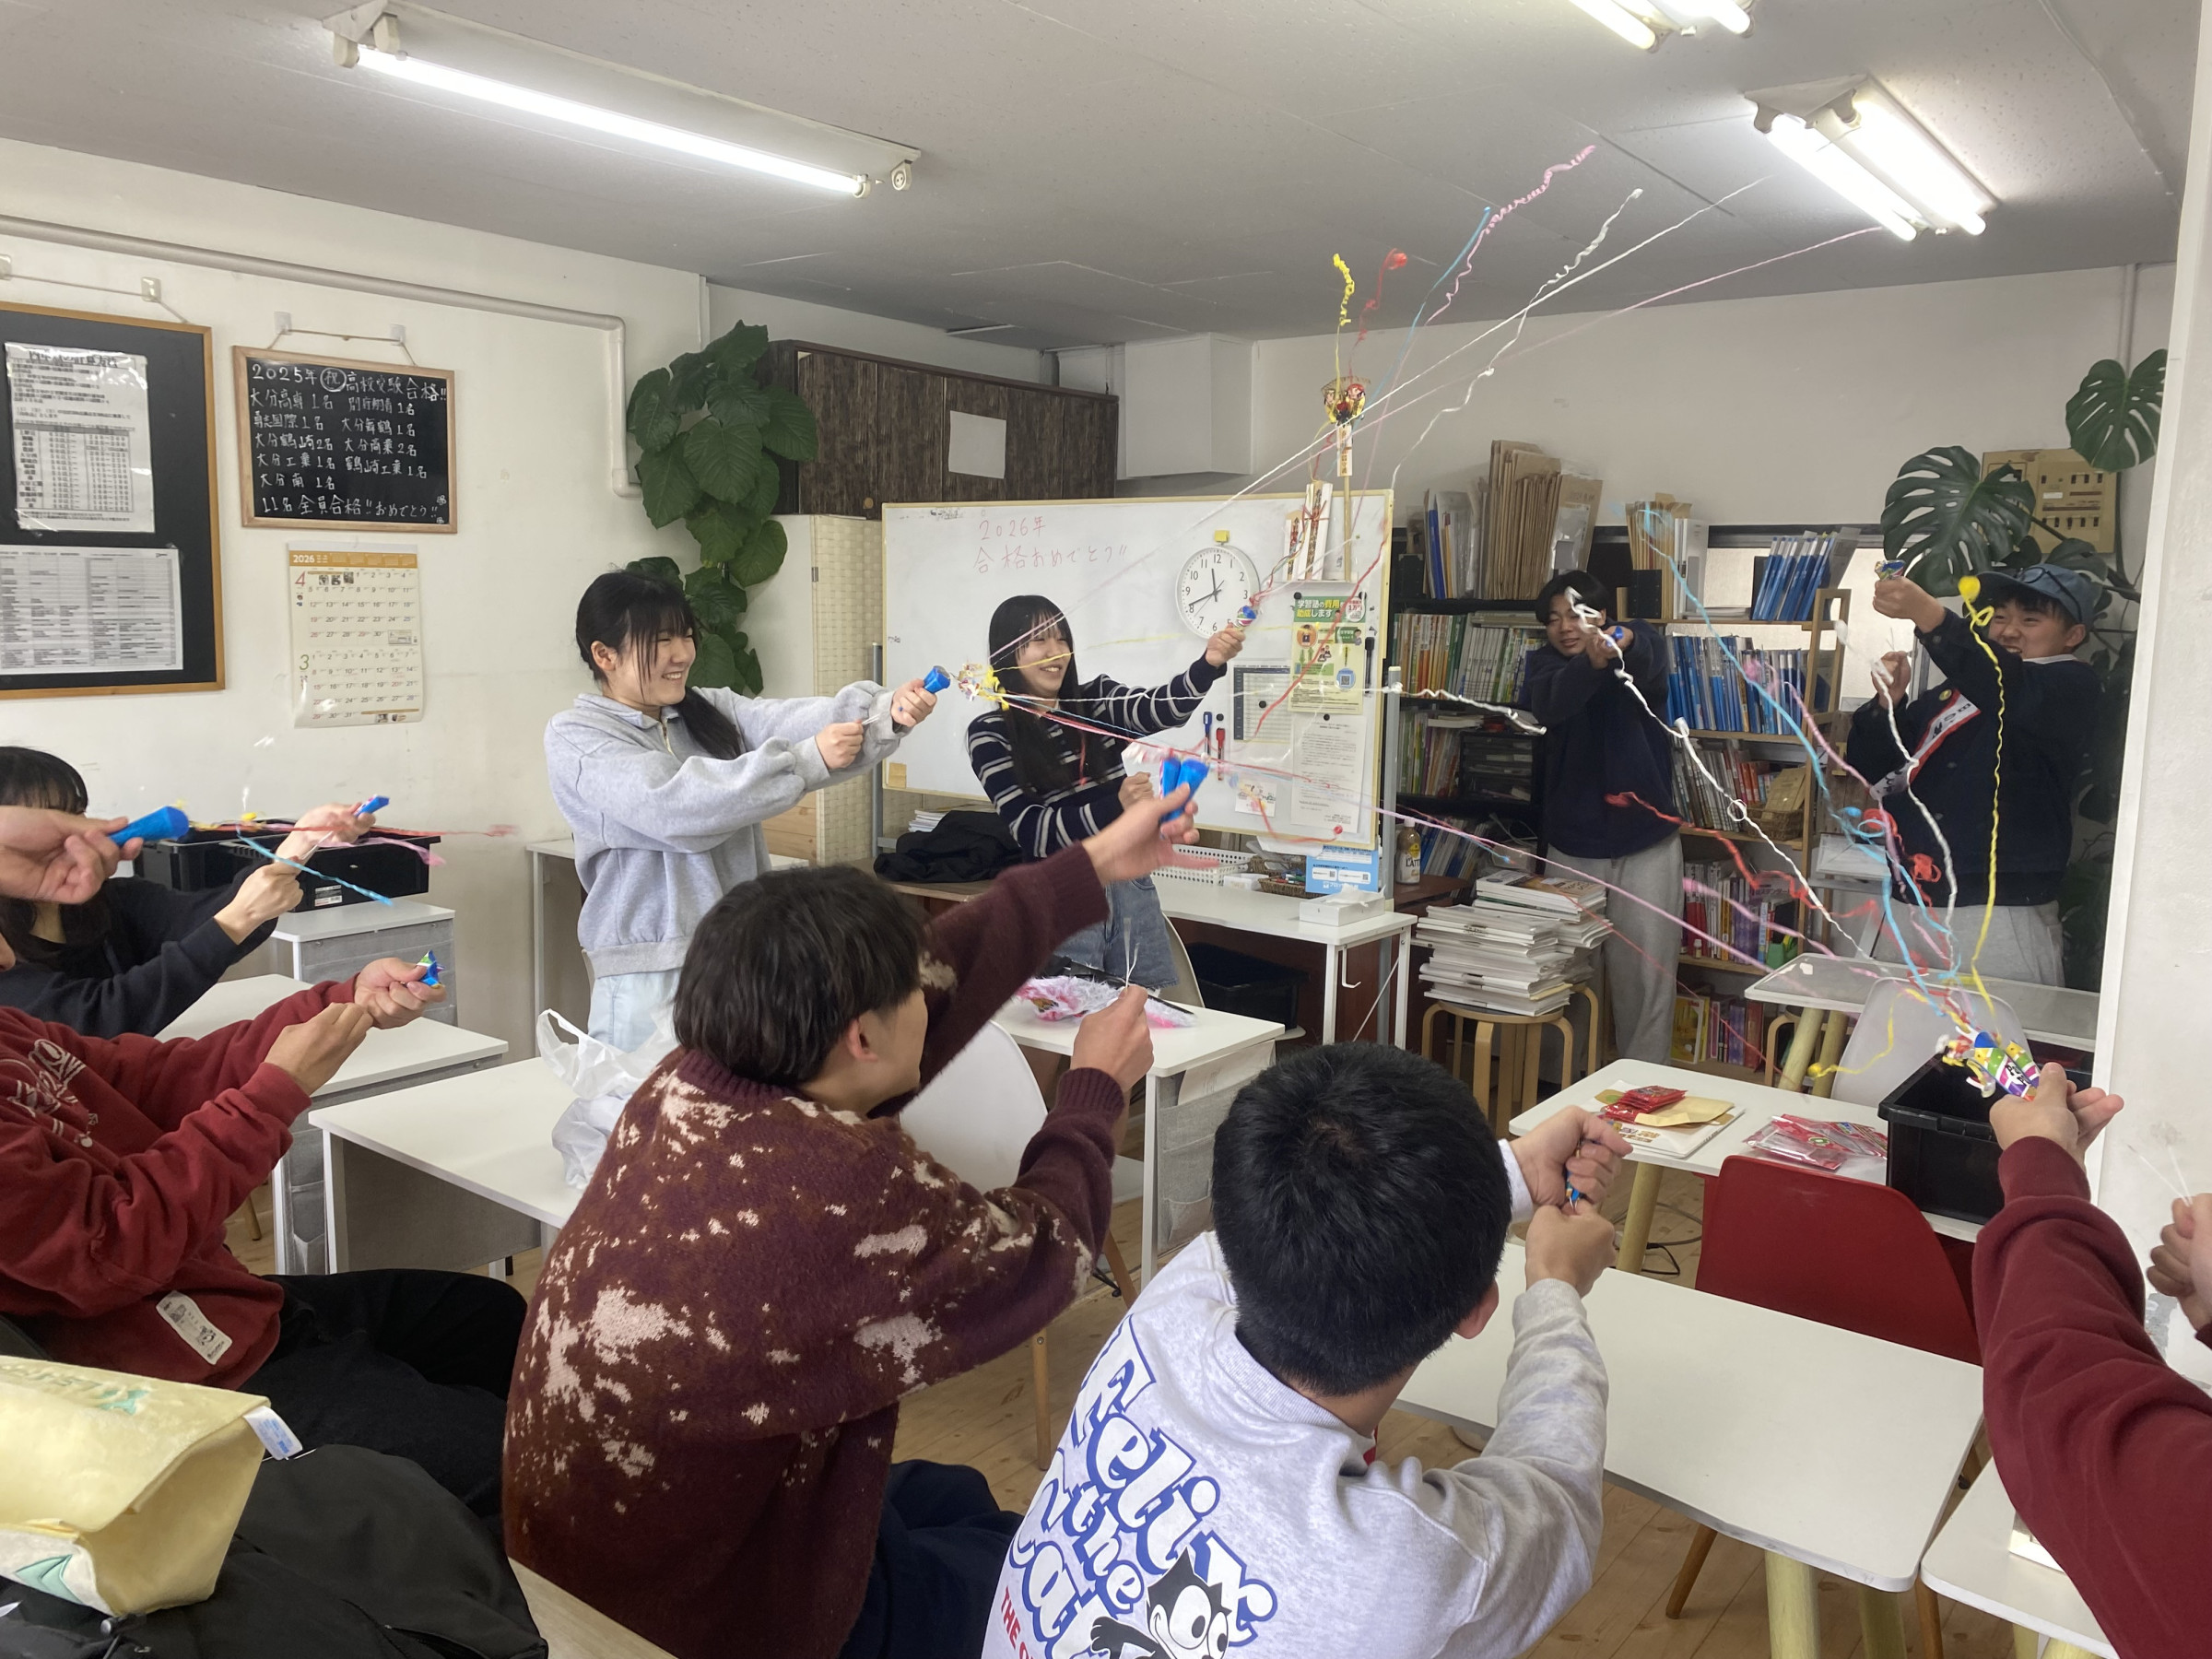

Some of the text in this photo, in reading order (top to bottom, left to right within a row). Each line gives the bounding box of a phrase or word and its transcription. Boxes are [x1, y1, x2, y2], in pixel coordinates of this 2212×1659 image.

[979, 516, 1046, 540] 2026年
[293, 555, 315, 563] 2026
[1201, 559, 1207, 569] 11
[1213, 554, 1221, 564] 12
[1230, 559, 1233, 569] 1
[295, 571, 306, 587] 4
[1190, 571, 1198, 581] 10
[1240, 571, 1244, 582] 2
[1185, 586, 1190, 595] 9
[1243, 590, 1248, 599] 3
[1189, 604, 1194, 614] 8
[1199, 617, 1204, 626] 7
[1212, 622, 1217, 631] 6
[300, 654, 310, 670] 3
[1072, 1314, 1277, 1647] Felix
[1063, 1482, 1146, 1615] the
[1001, 1585, 1021, 1650] THE
